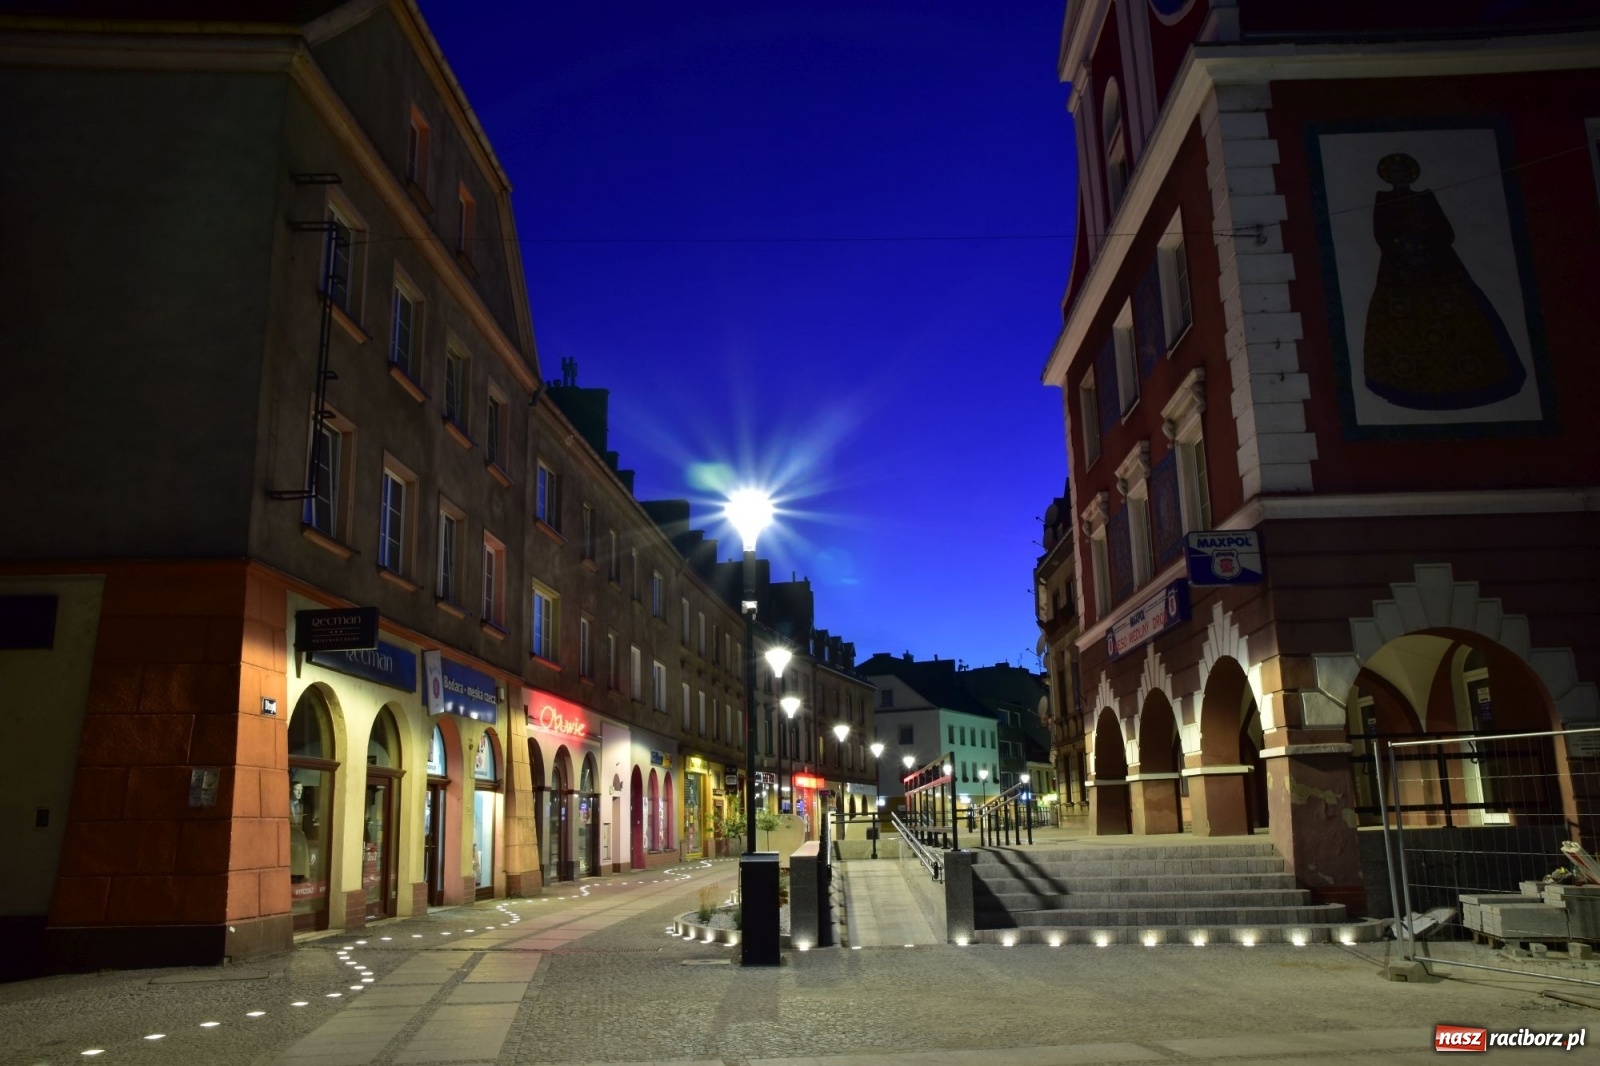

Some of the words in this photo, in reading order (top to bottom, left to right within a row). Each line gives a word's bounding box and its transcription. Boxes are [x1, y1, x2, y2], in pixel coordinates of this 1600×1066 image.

[1197, 537, 1252, 548] MAXPOL
[1130, 610, 1146, 628] MAXPOL
[443, 675, 464, 694] Bodara
[467, 687, 483, 701] męska
[540, 705, 586, 737] Obuwie
